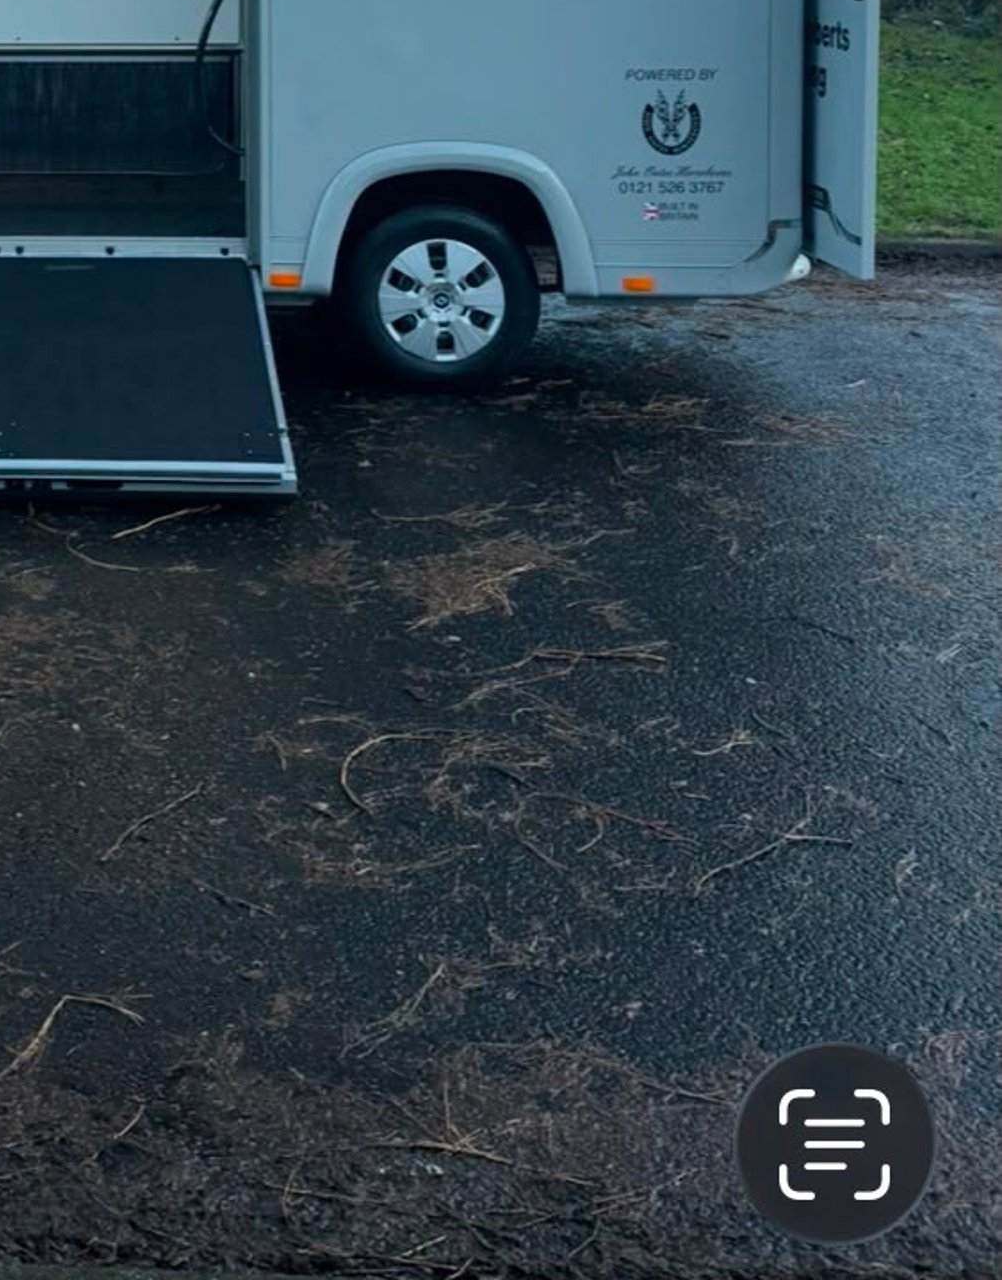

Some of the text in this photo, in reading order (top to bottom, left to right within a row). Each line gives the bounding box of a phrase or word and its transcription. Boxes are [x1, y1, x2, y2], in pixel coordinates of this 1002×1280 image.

[625, 68, 718, 81] POWERED BY
[618, 181, 725, 194] 0121 526 3767
